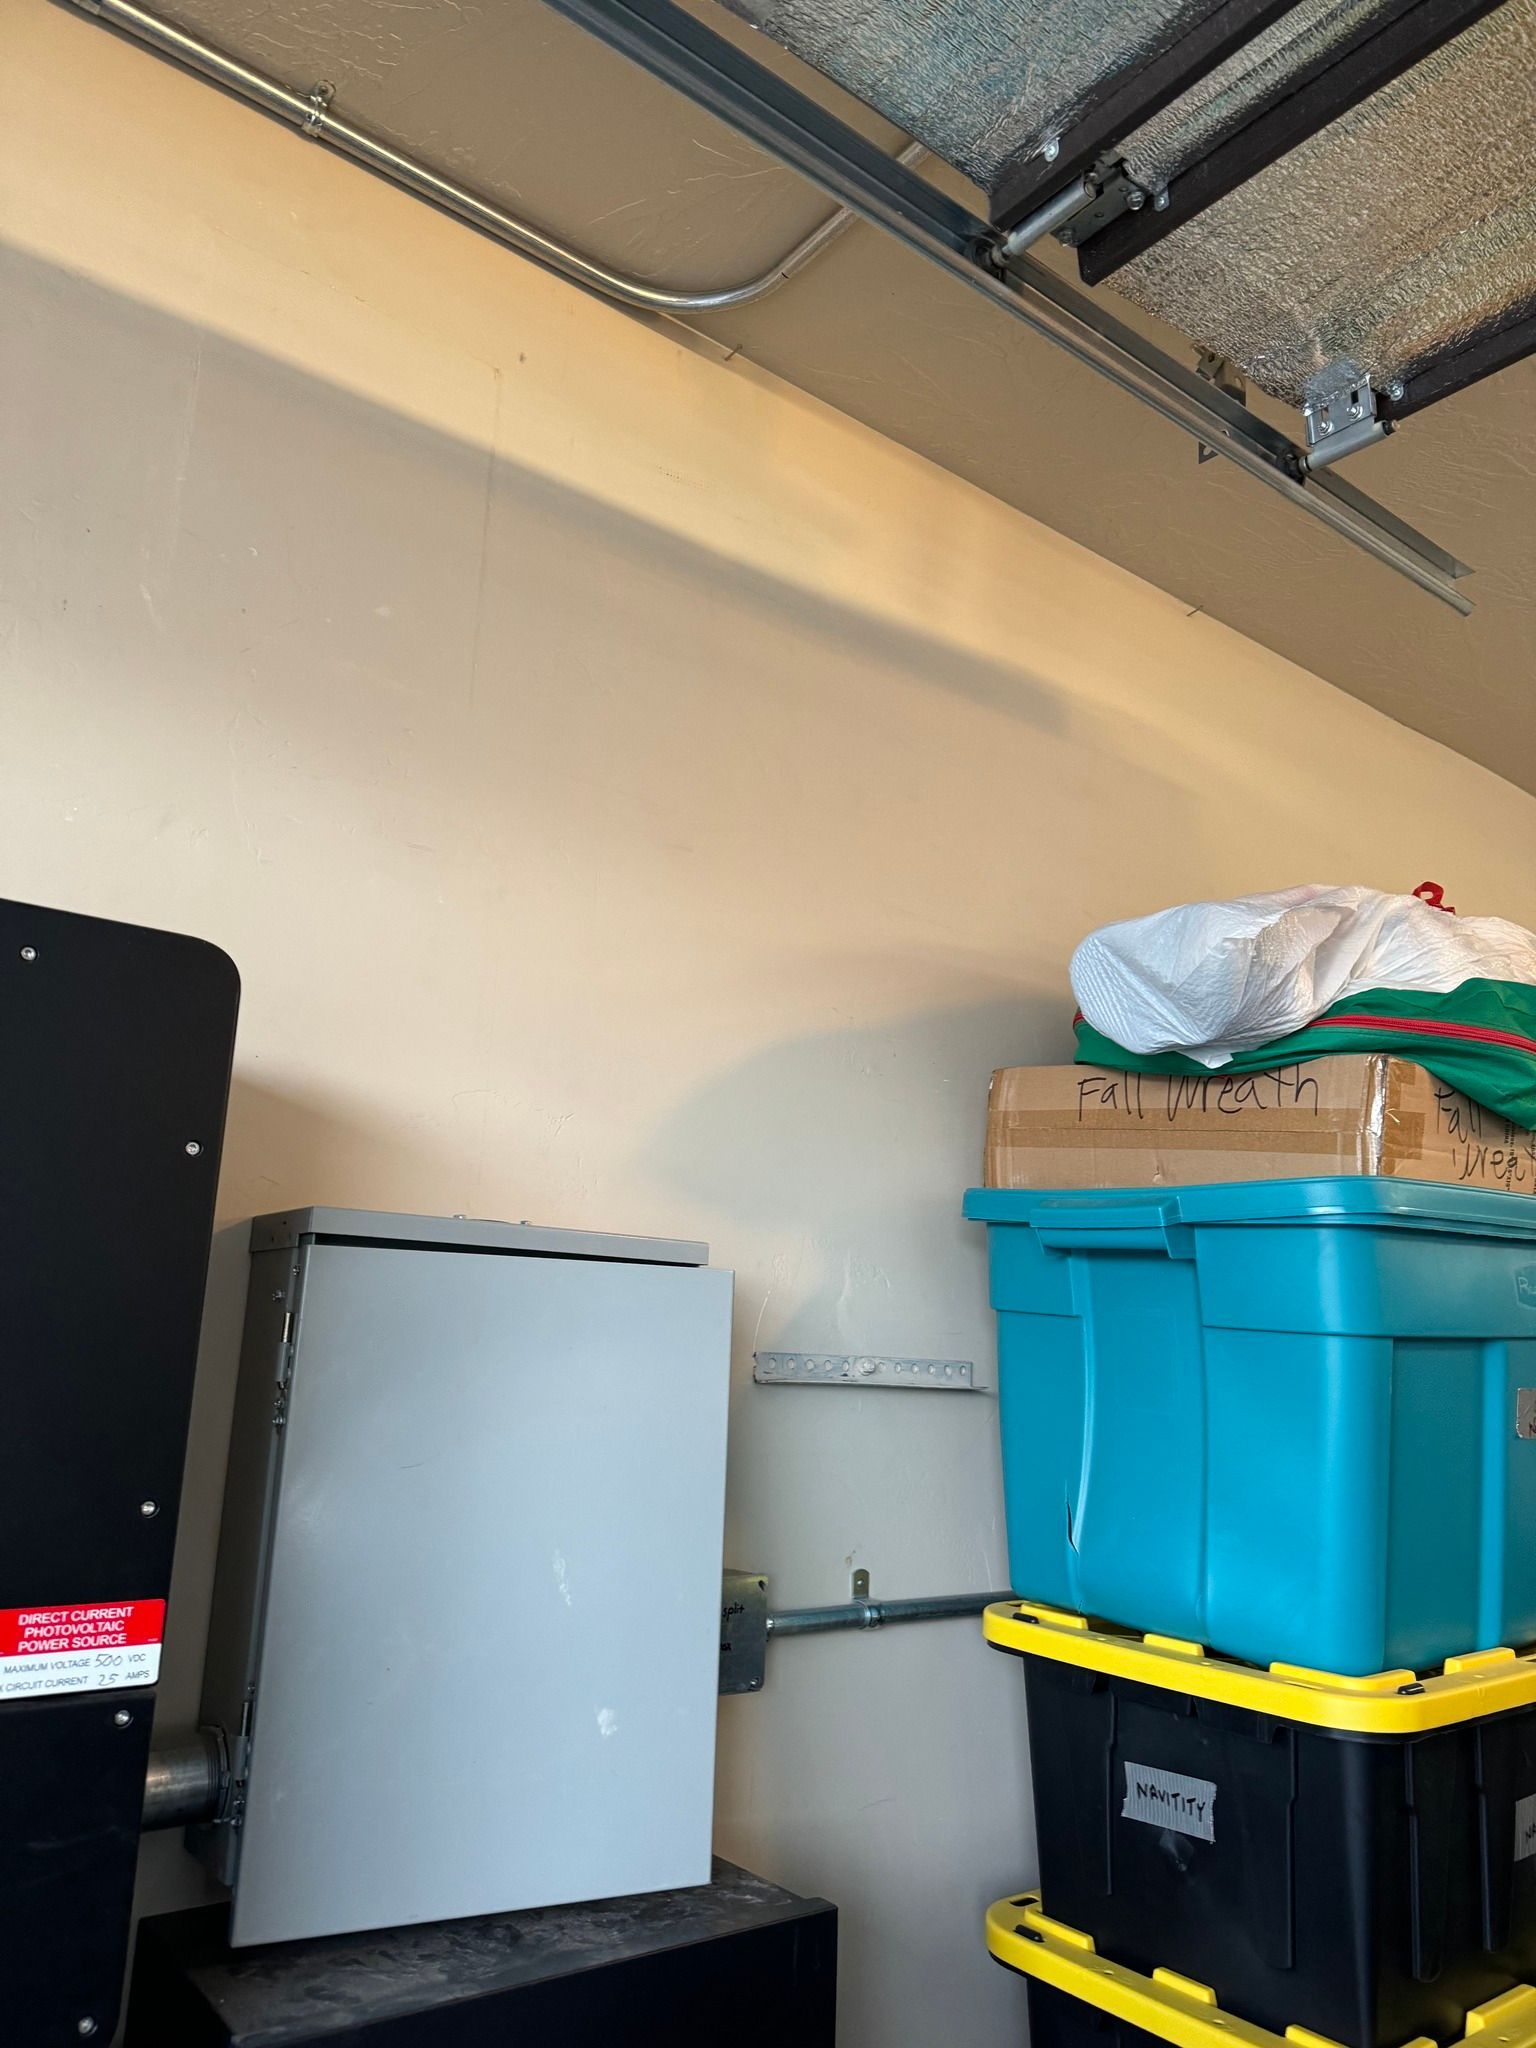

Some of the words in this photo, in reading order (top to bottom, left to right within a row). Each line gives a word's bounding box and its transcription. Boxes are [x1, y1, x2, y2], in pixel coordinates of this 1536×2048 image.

[1077, 1071, 1144, 1122] Fall
[1167, 1063, 1319, 1122] Wreath
[1433, 1087, 1482, 1144] Fall
[18, 1610, 70, 1626] DIRECT
[70, 1606, 134, 1621] CURRENT
[722, 1601, 745, 1622] split
[23, 1620, 125, 1639] PHOTOVOLTAIC
[17, 1637, 69, 1653] POWER
[71, 1632, 128, 1649] SOURCE
[3, 1662, 48, 1674] MAXIMUM
[50, 1658, 91, 1670] VOLTAGE
[94, 1653, 124, 1668] 500
[128, 1653, 146, 1663] VDC
[5, 1680, 43, 1692] CIRCUIT
[44, 1675, 88, 1688] CURRENT
[98, 1673, 120, 1687] 25
[125, 1670, 150, 1681] AMPS
[1136, 1781, 1206, 1822] NAVITITY
